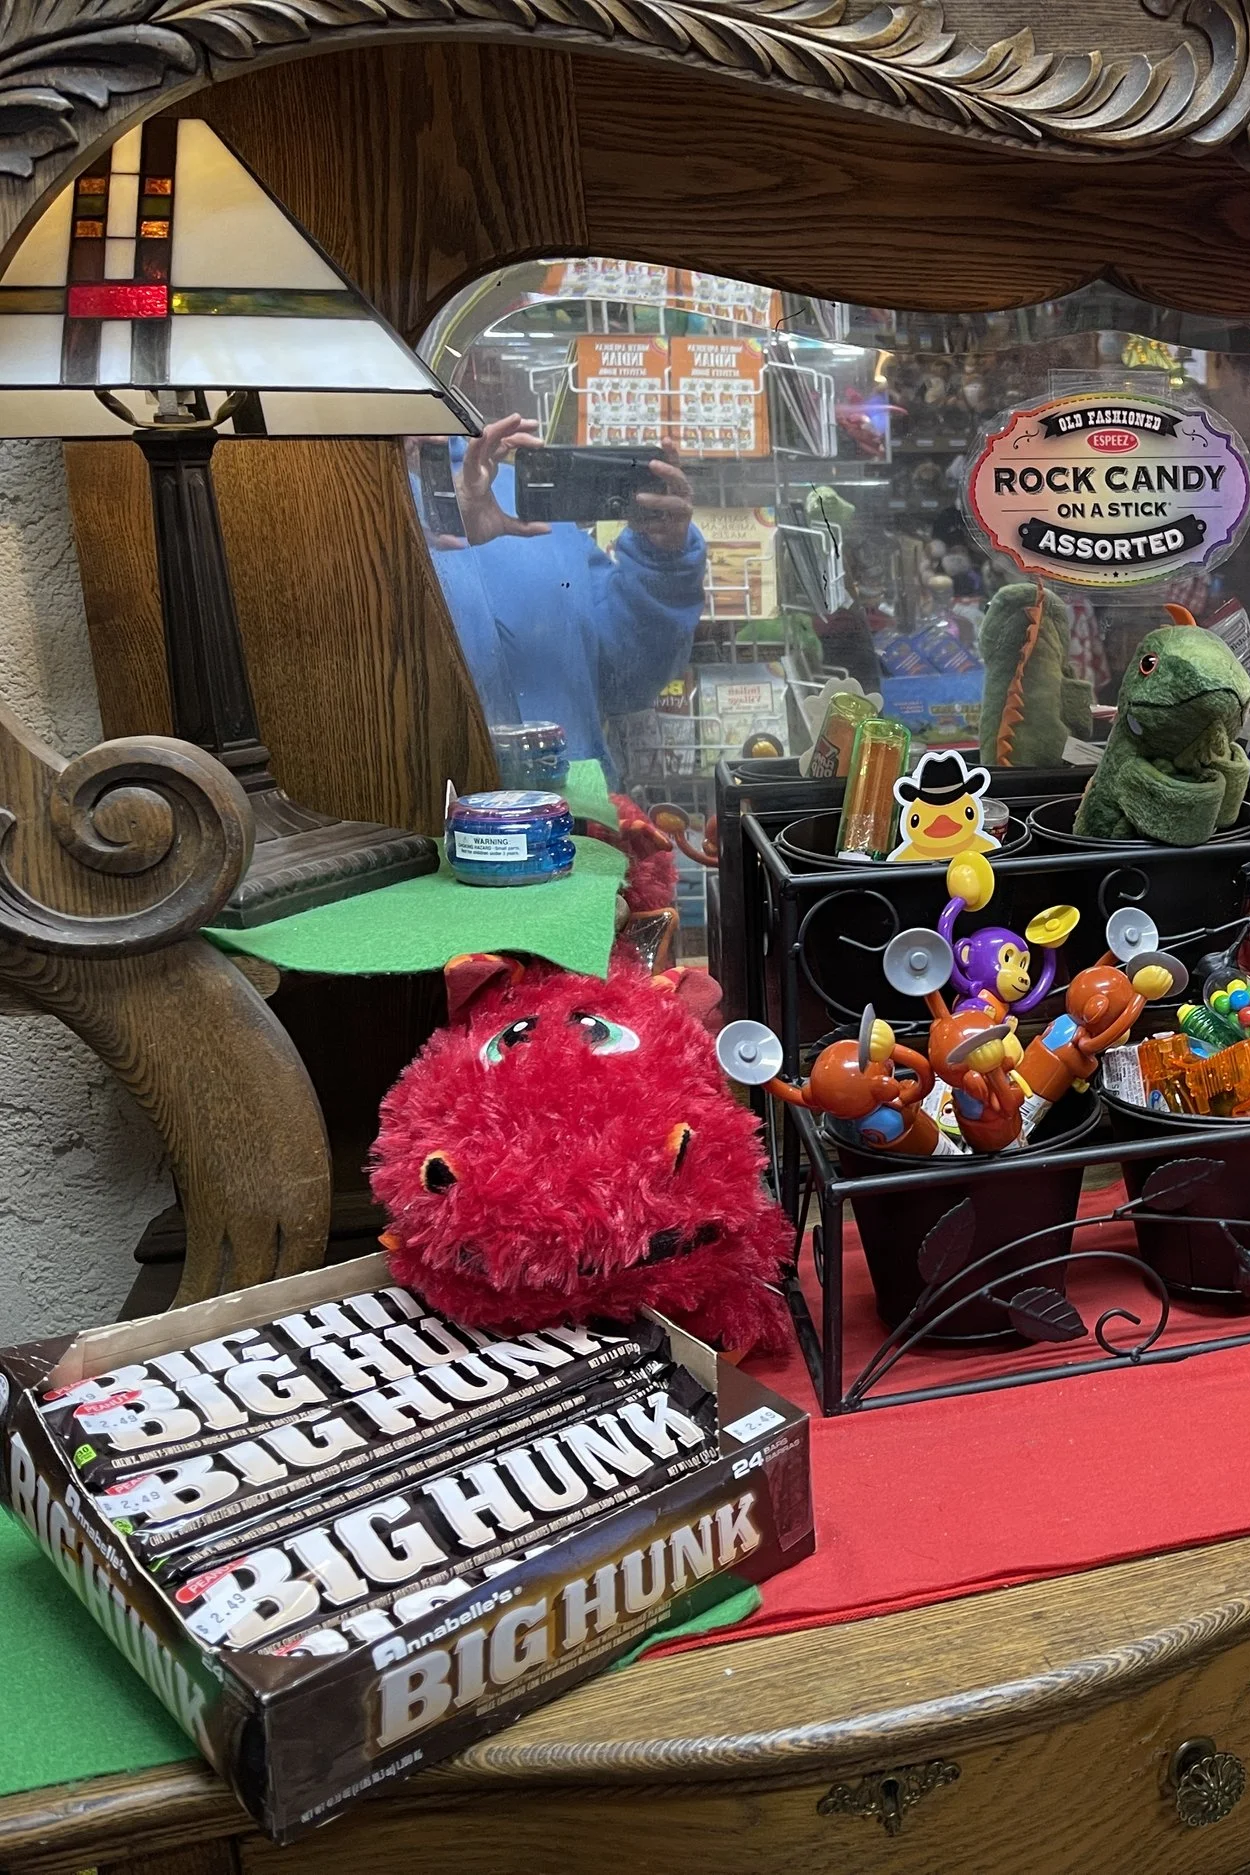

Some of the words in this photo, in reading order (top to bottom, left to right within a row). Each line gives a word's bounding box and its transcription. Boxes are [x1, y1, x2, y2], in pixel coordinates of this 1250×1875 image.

[1058, 414, 1083, 431] OLD
[1087, 410, 1162, 431] FASHIONED
[1093, 435, 1130, 447] ESPEEZ
[994, 467, 1096, 494] ROCK
[1104, 465, 1226, 493] CANDY
[1057, 503, 1086, 519] ON
[1090, 503, 1104, 518] A
[1108, 502, 1168, 518] STICK
[1038, 528, 1185, 561] ASSORTED
[84, 1393, 130, 1413] PEANUT
[107, 1354, 329, 1451] BIG
[100, 1414, 138, 1429] 2.49
[140, 1416, 369, 1524] BIG
[349, 1323, 630, 1436] HUNK
[747, 1410, 777, 1432] 2.49
[763, 1437, 788, 1455] BARS
[731, 1451, 765, 1480] 24
[10, 1431, 79, 1572] BIG
[121, 1491, 161, 1510] 2.49
[64, 1483, 128, 1580] Annabelle's
[224, 1496, 449, 1650] BIG
[421, 1391, 706, 1549] HUNK
[210, 1592, 247, 1624] 2.49
[376, 1597, 547, 1749] BIG
[562, 1491, 761, 1650] HUNK
[372, 1585, 513, 1672] Annabelle's
